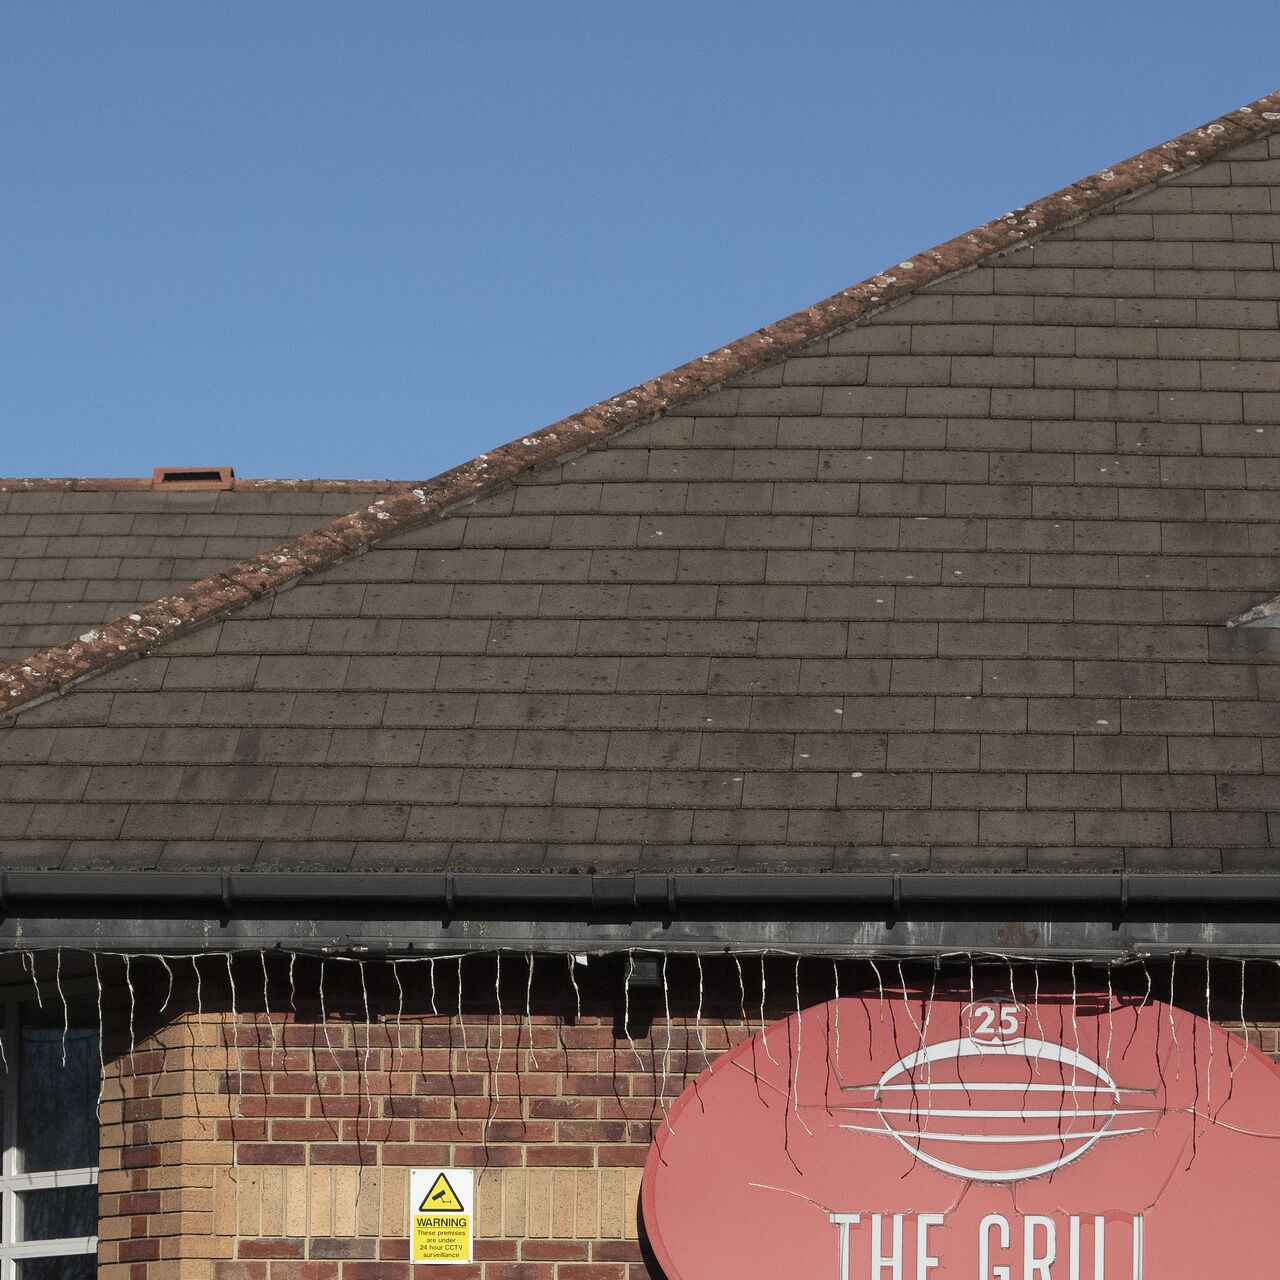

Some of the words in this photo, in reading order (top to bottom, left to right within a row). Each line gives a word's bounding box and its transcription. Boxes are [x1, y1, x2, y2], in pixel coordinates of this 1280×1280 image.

[973, 1006, 1019, 1035] 25
[416, 1217, 467, 1227] WARNING
[437, 1229, 466, 1237] premises
